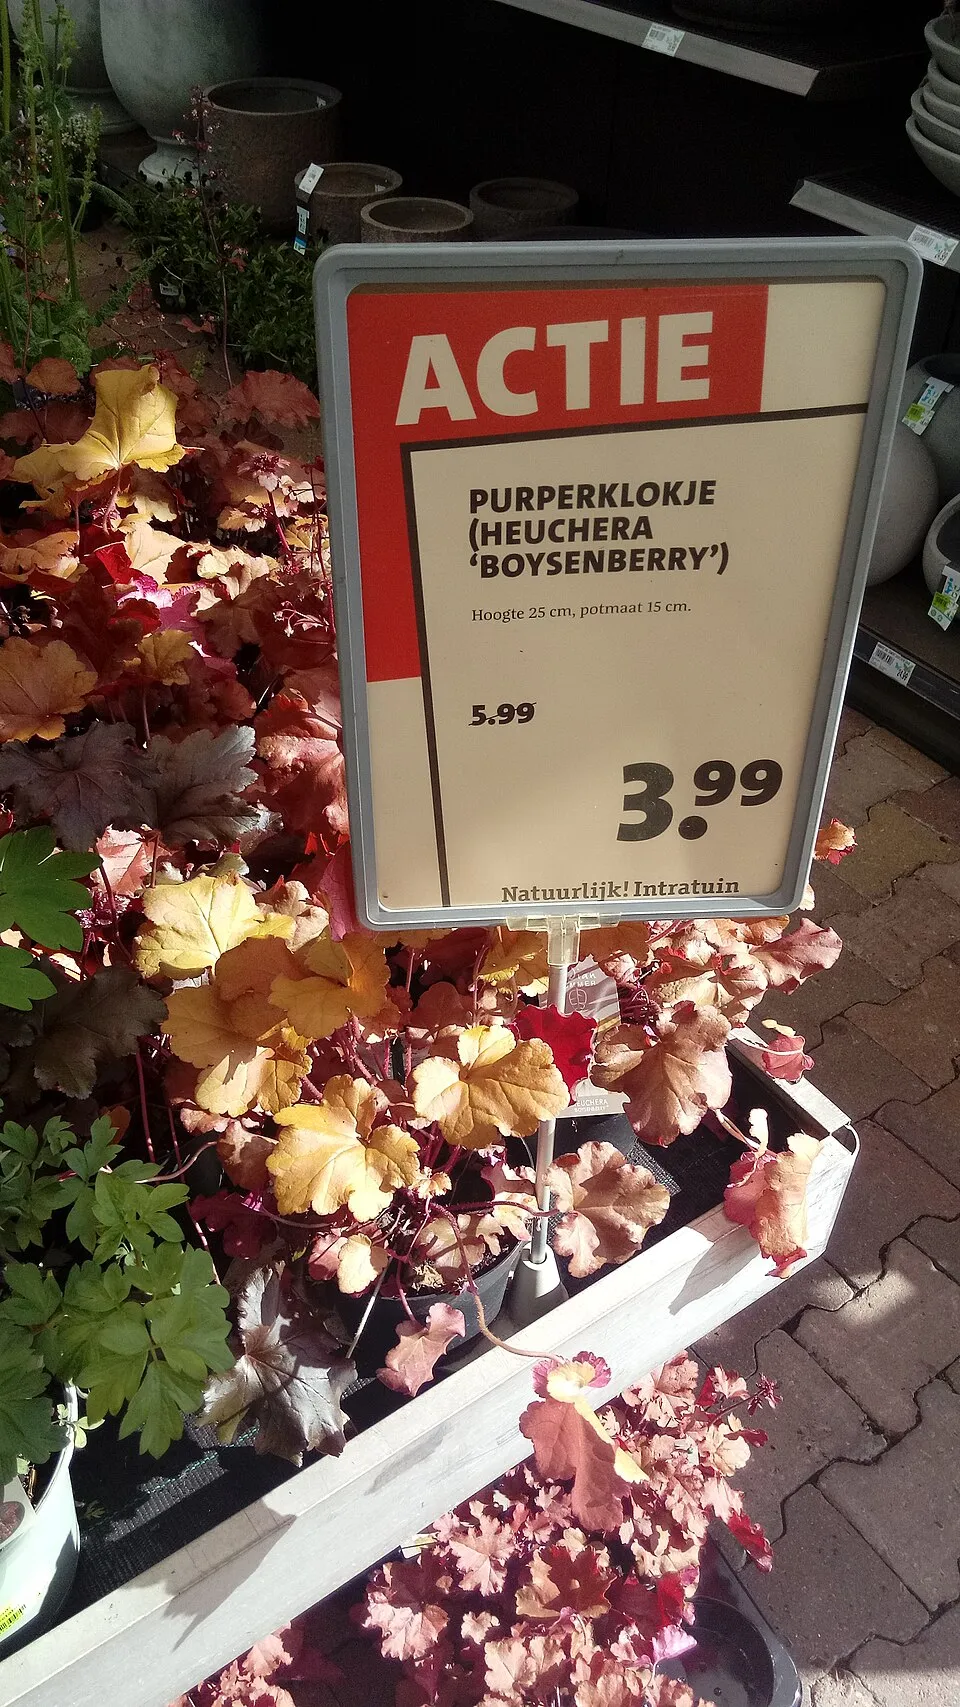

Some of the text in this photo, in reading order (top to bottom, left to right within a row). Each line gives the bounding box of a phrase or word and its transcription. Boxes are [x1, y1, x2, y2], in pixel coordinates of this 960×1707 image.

[395, 311, 714, 426] ACTIE
[469, 479, 717, 514] PURPERKLOKJE
[468, 515, 654, 552] (HEUCHERA
[471, 601, 692, 624] Hoogte 25 cm, potmaat 15 cm.
[469, 702, 537, 726] 5.99
[616, 759, 784, 842] 3.99
[501, 877, 740, 902] Natuurlijk! Intratuin
